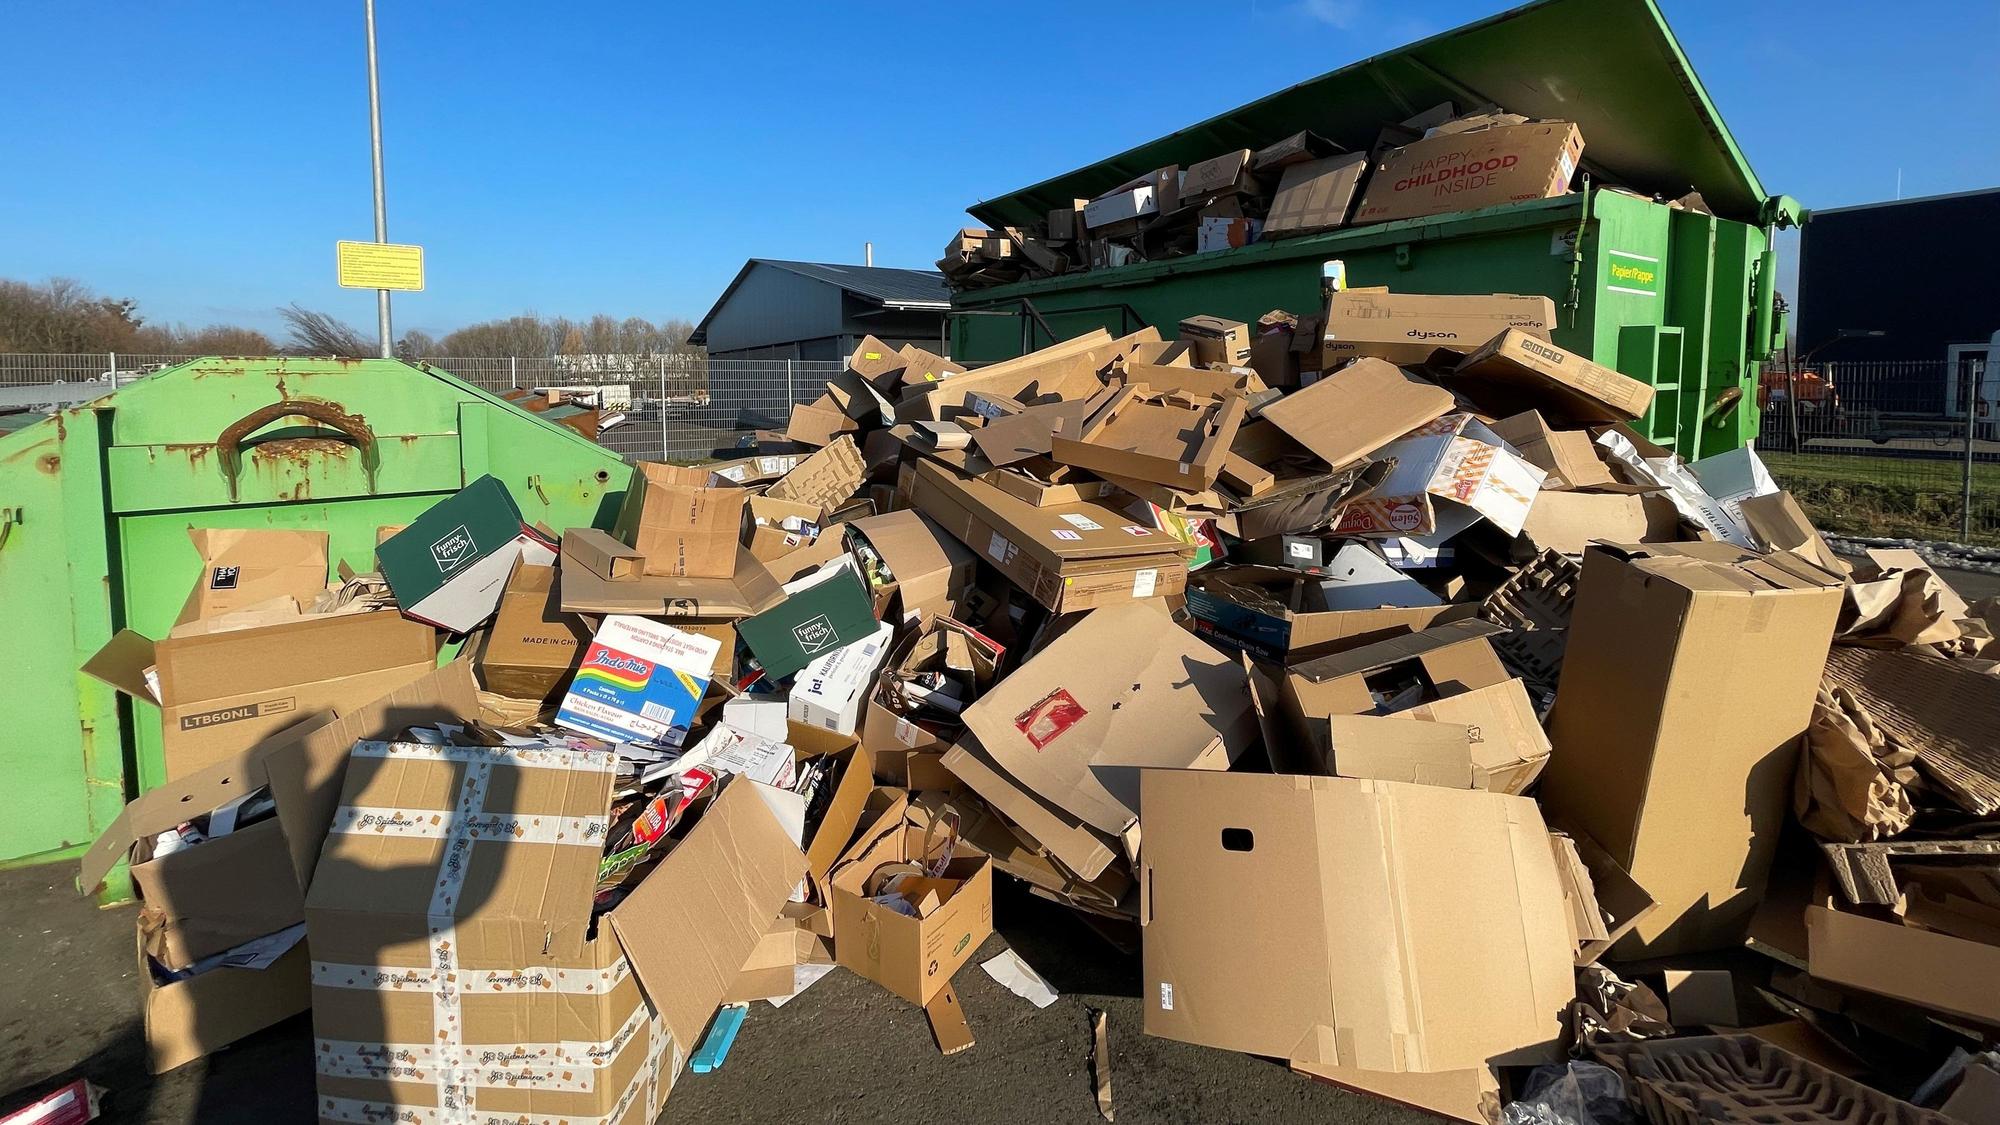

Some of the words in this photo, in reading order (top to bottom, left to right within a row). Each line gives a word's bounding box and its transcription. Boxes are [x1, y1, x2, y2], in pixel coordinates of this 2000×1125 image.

[1411, 149, 1472, 174] HAPPY
[1394, 155, 1519, 191] CHILDHOOD
[1433, 172, 1498, 197] INSIDE
[1611, 263, 1654, 284] Papier/Pappe
[1509, 320, 1543, 329] dyson
[1407, 329, 1457, 340] dyson
[1325, 341, 1355, 351] dyson
[1700, 507, 1717, 523] TRAPP
[1714, 523, 1731, 538] TRIPP
[442, 539, 467, 558] frisch
[522, 637, 548, 645] MADE
[549, 637, 559, 645] IN
[805, 626, 829, 642] frisch
[808, 678, 823, 695] ja!
[570, 697, 596, 710] Chicken
[597, 705, 623, 719] Flavour
[184, 708, 253, 728] LTB60NL
